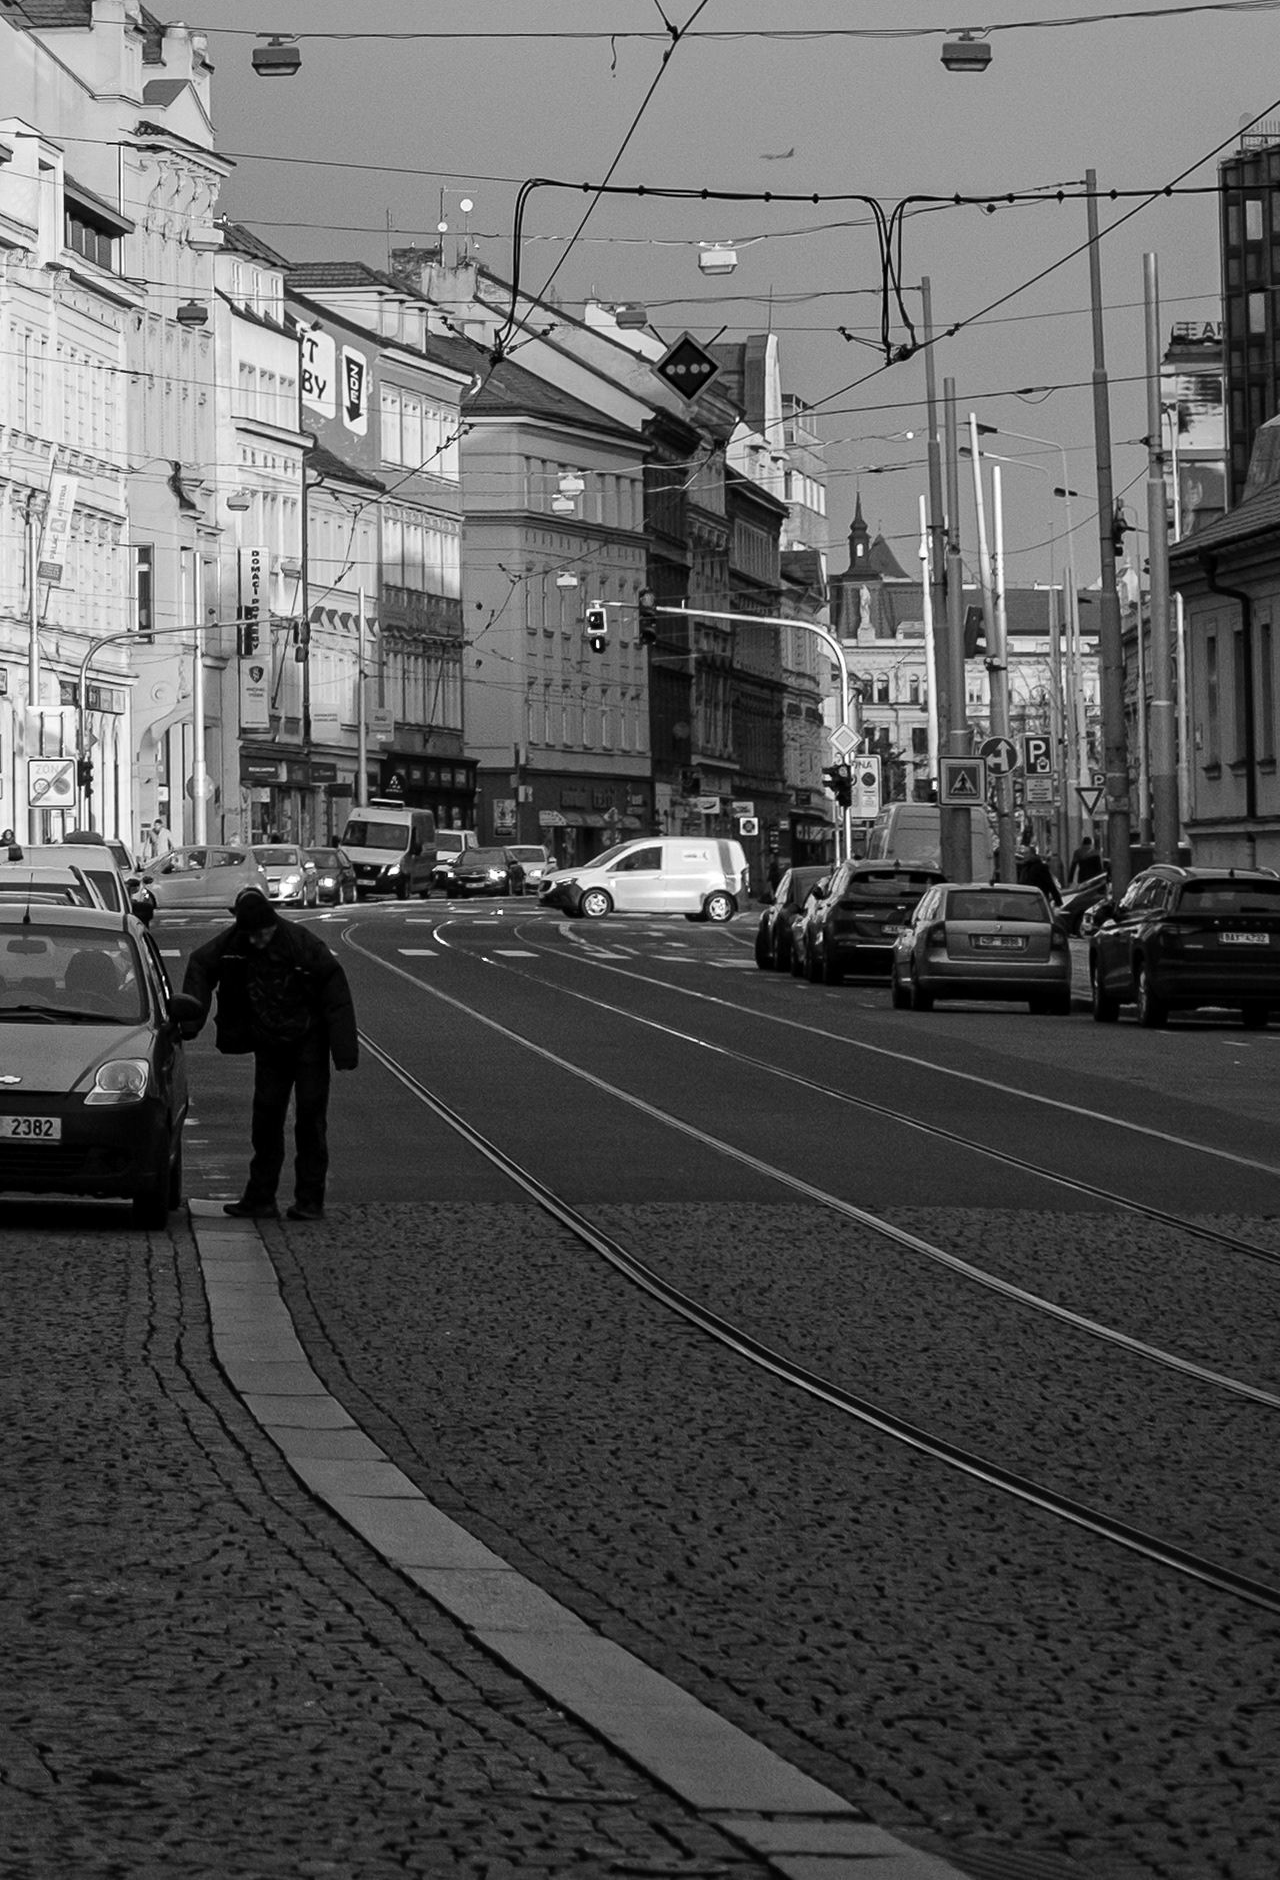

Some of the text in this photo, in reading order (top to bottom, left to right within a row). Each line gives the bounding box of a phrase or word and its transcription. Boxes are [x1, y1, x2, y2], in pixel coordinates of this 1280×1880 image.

[349, 364, 359, 404] ZDE
[1030, 740, 1046, 763] P
[11, 1118, 53, 1136] 2382
